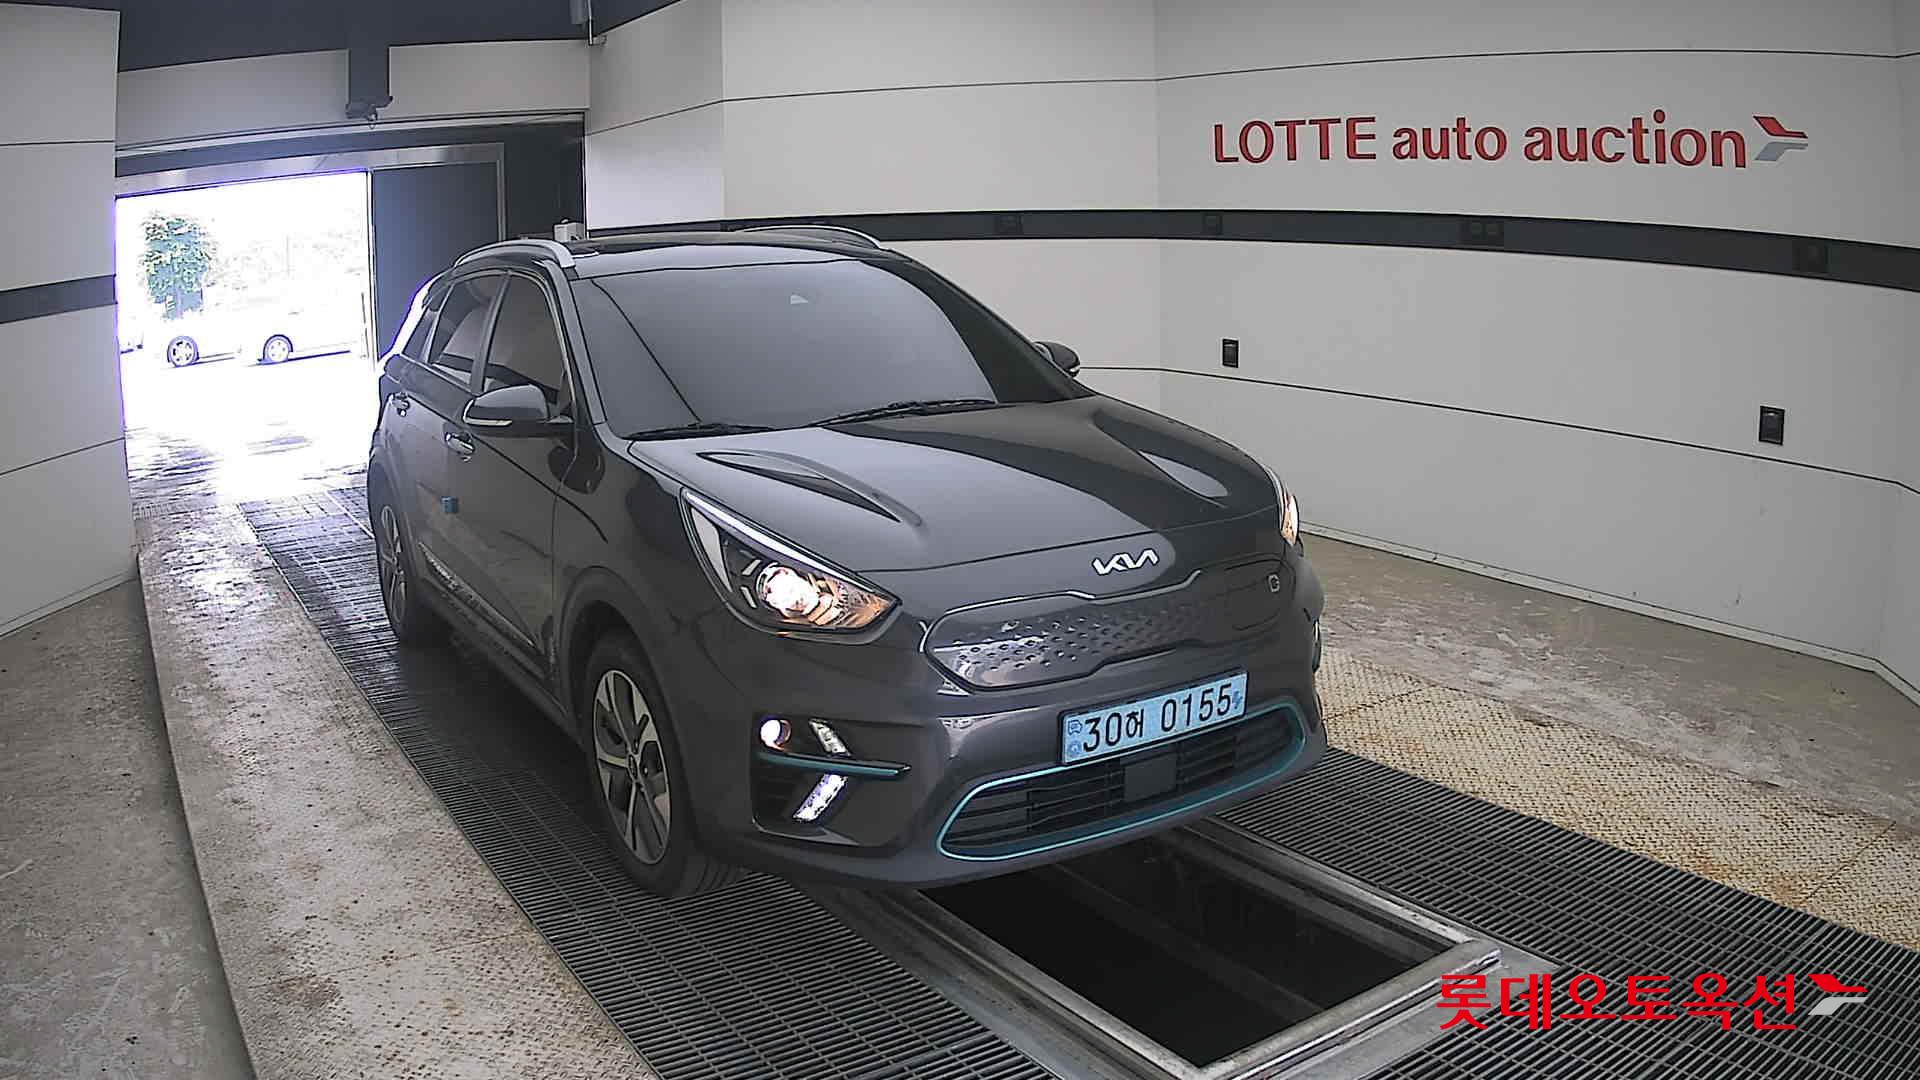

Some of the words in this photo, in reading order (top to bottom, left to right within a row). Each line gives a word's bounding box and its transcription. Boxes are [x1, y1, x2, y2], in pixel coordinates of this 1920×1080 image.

[1213, 116, 1377, 164] LOTTE
[1391, 117, 1508, 161] auto
[1523, 109, 1747, 168] auction
[1083, 708, 1145, 752] 30허
[1160, 682, 1233, 733] 0155
